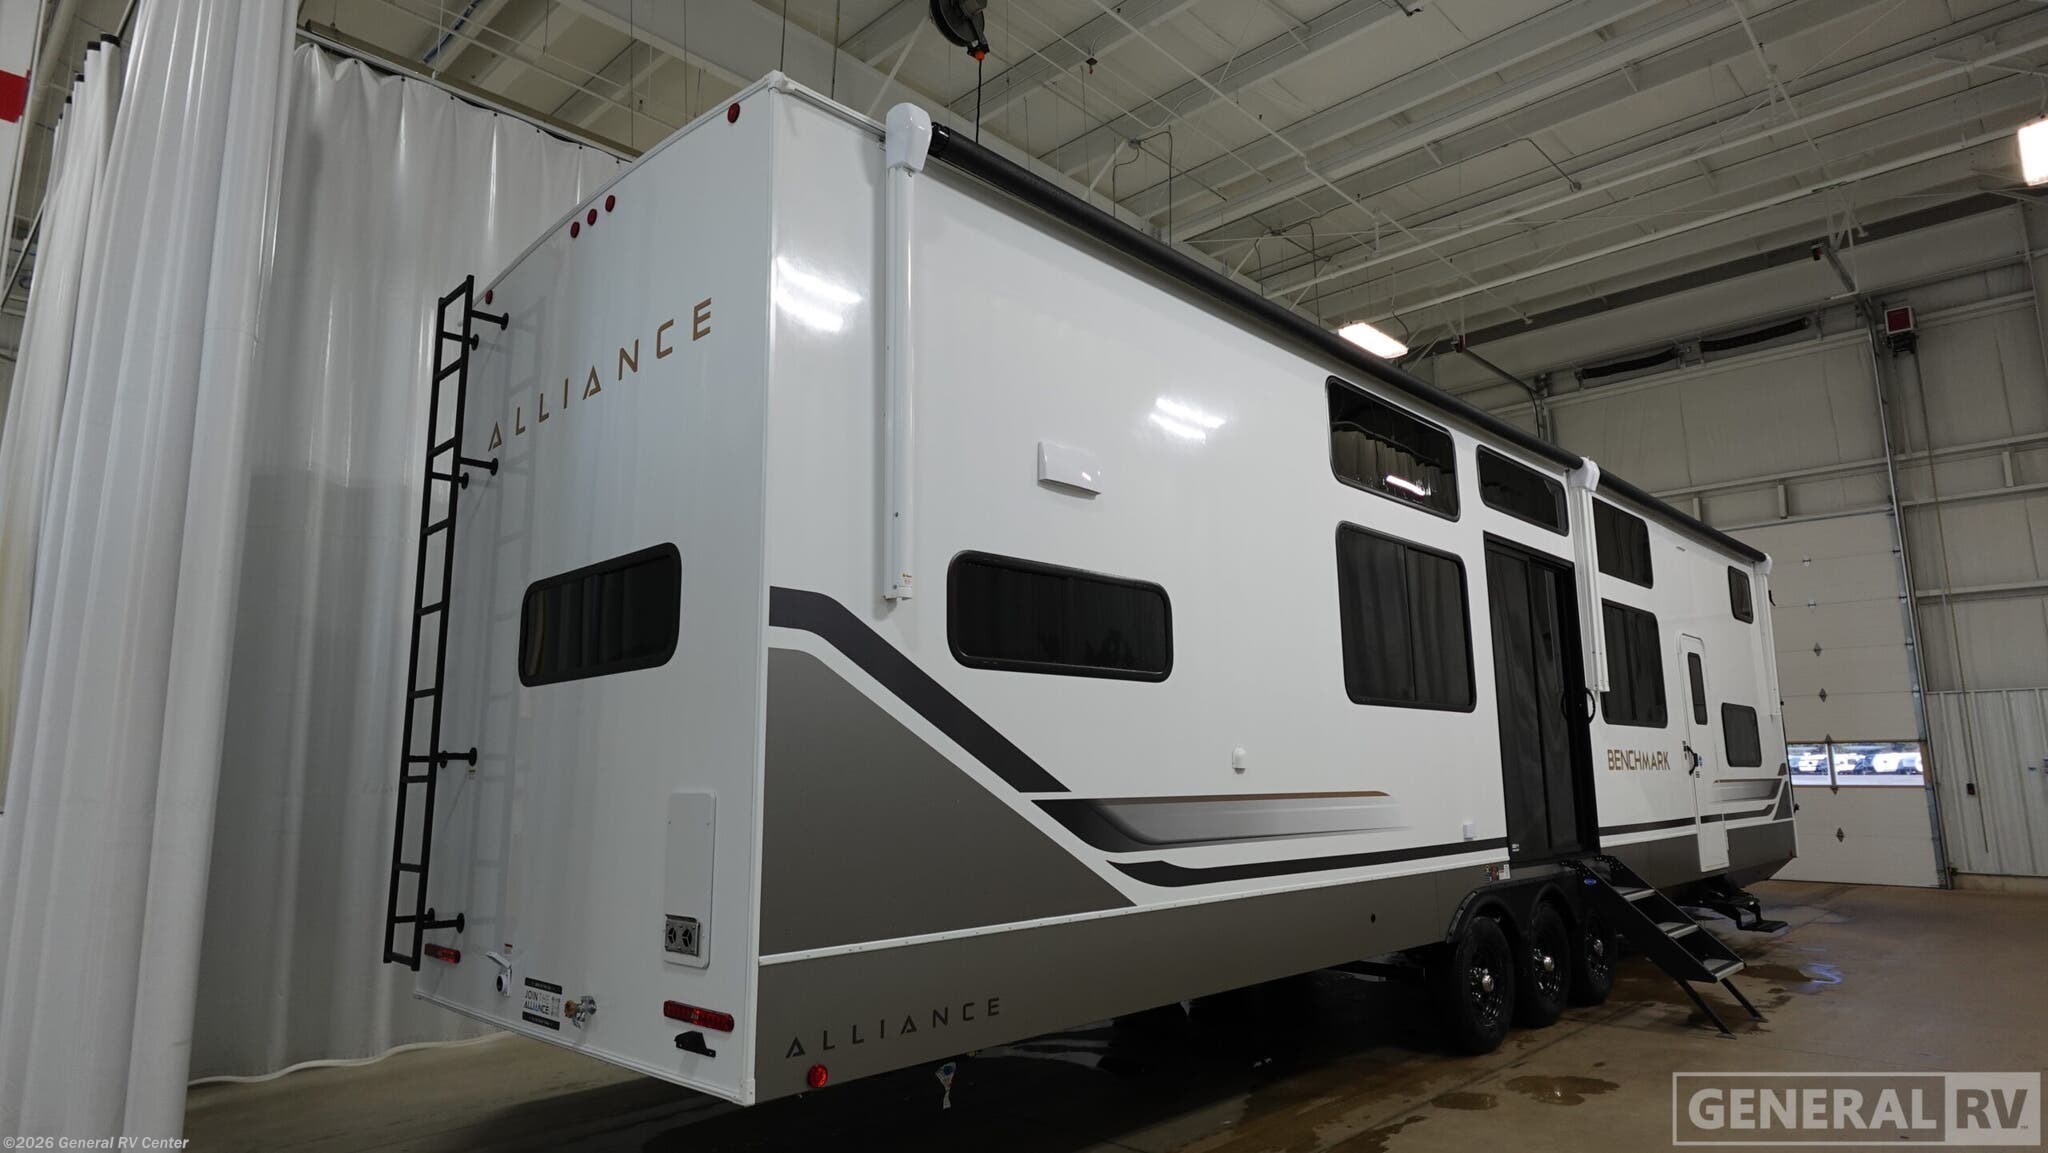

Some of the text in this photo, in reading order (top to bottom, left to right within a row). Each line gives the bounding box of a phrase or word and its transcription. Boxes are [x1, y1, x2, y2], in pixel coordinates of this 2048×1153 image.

[488, 297, 713, 452] ALLIANCE
[1607, 749, 1671, 770] BENCHMARK
[525, 989, 538, 1001] JOIN
[523, 1000, 550, 1015] ALLIANCE
[785, 997, 1000, 1058] ALLIANCE
